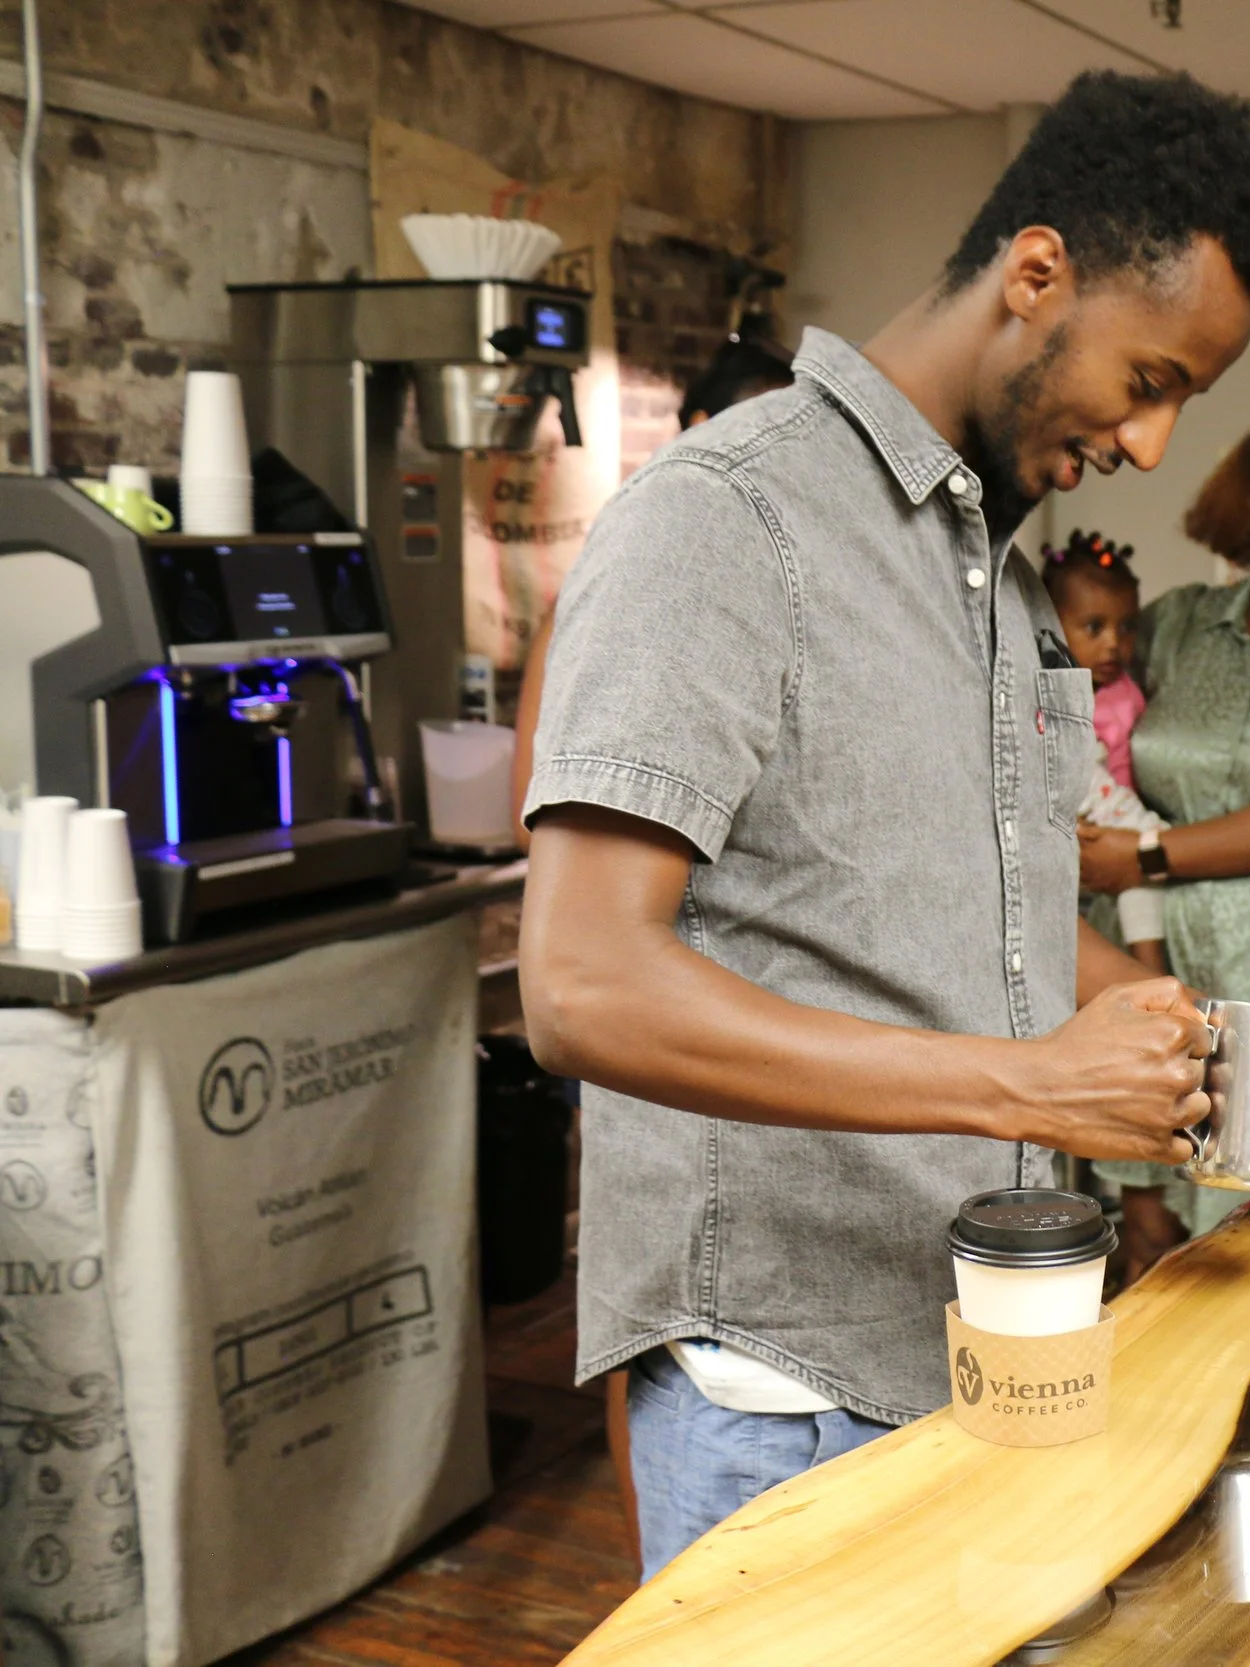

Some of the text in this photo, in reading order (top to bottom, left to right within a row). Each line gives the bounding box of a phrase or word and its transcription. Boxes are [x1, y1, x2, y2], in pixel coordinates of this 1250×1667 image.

[0, 1255, 103, 1296] IMO
[988, 1373, 1096, 1400] vienna
[992, 1402, 1059, 1416] COFFEE
